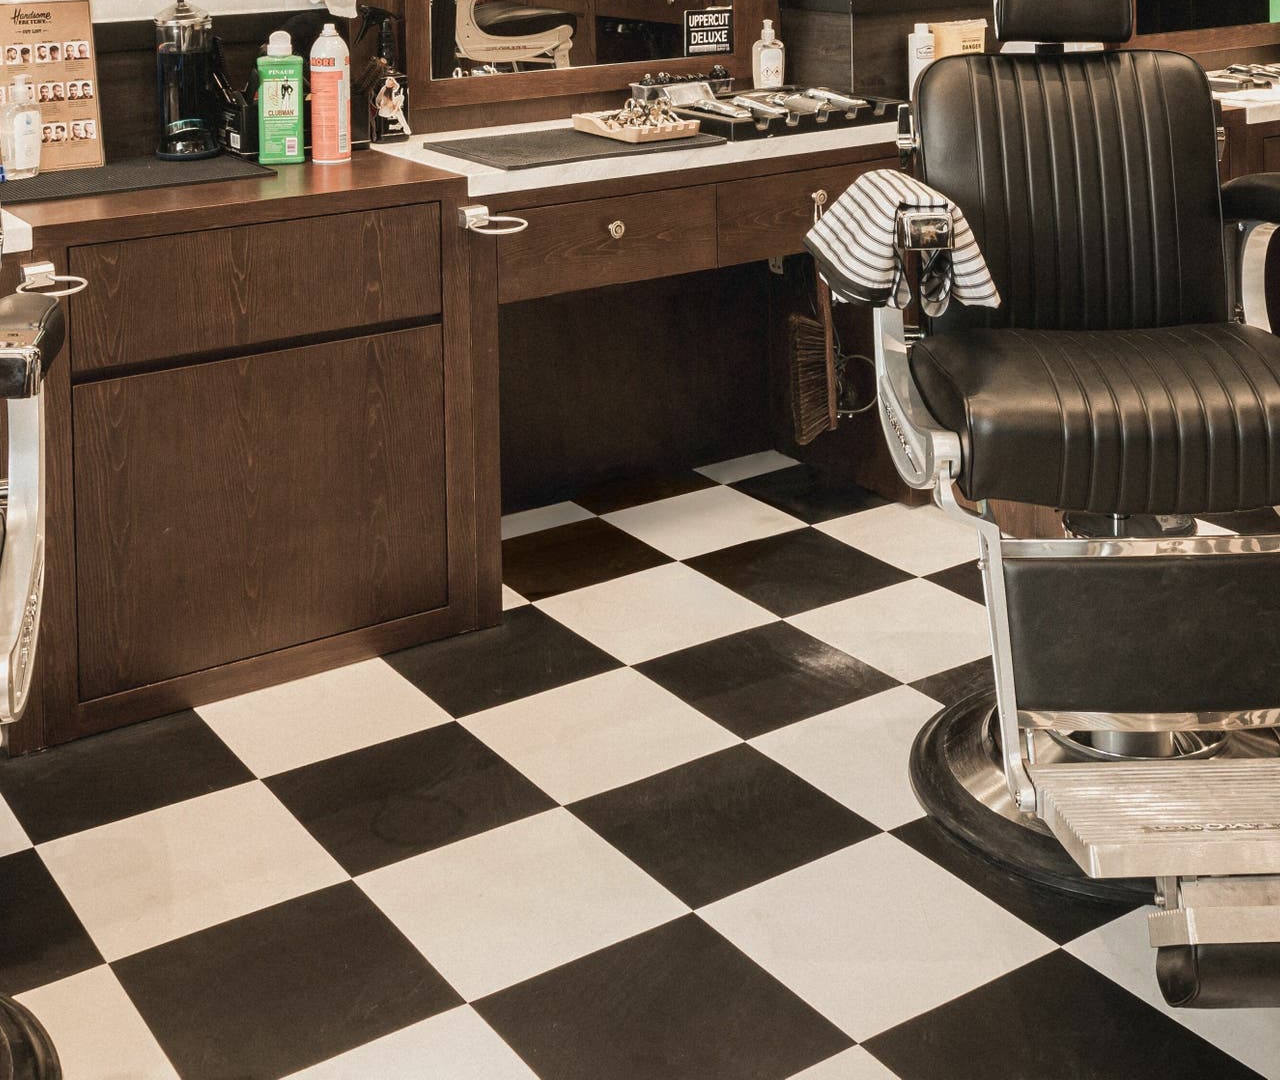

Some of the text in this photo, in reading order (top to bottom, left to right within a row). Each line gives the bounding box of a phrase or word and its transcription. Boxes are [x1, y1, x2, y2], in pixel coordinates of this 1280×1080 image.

[11, 8, 52, 24] Handsome
[688, 13, 730, 28] UPPERCUT
[691, 30, 728, 44] DELUXE
[267, 109, 294, 117] CLUBMAN
